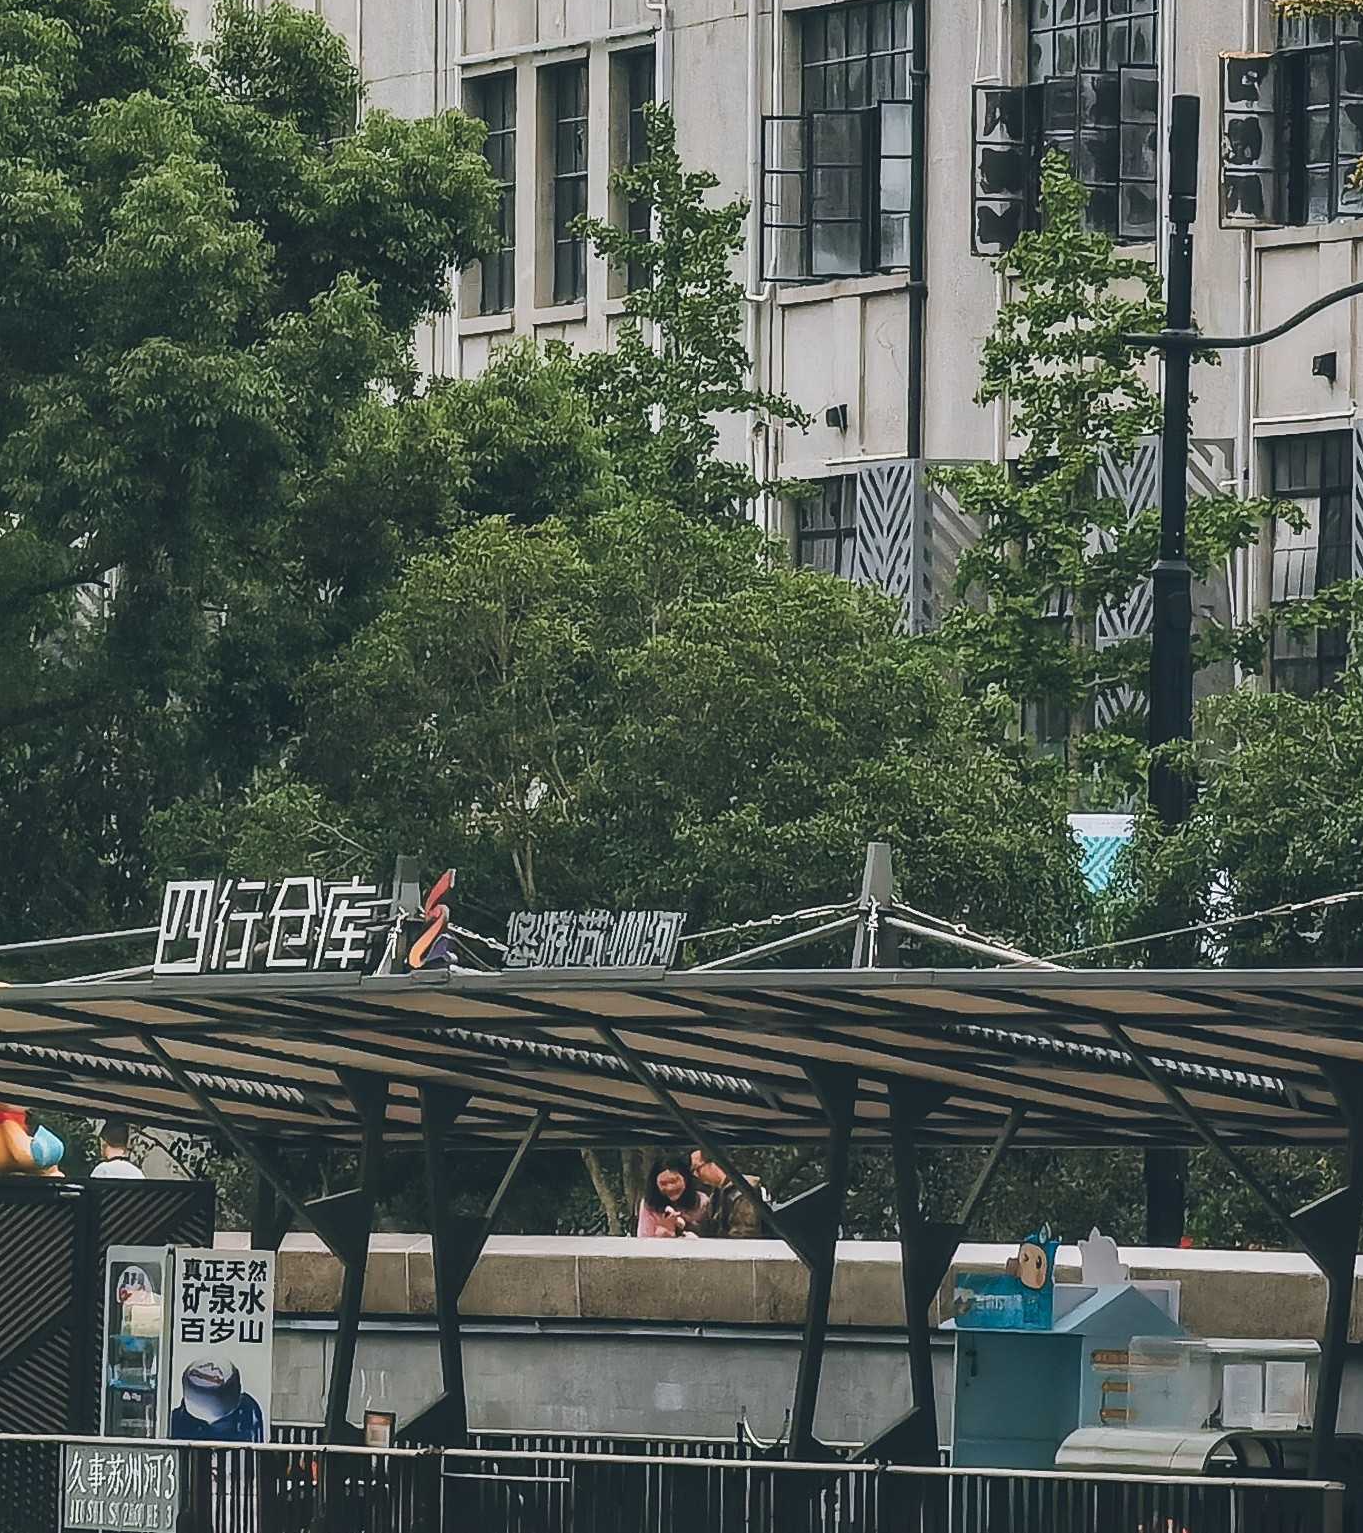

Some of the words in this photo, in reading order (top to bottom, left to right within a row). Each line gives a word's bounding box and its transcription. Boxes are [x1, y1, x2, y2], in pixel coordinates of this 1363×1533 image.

[153, 875, 377, 974] 四行仓库
[182, 1258, 268, 1282] 真正天然
[181, 1282, 266, 1316] 矿泉水
[180, 1317, 264, 1344] 百岁山
